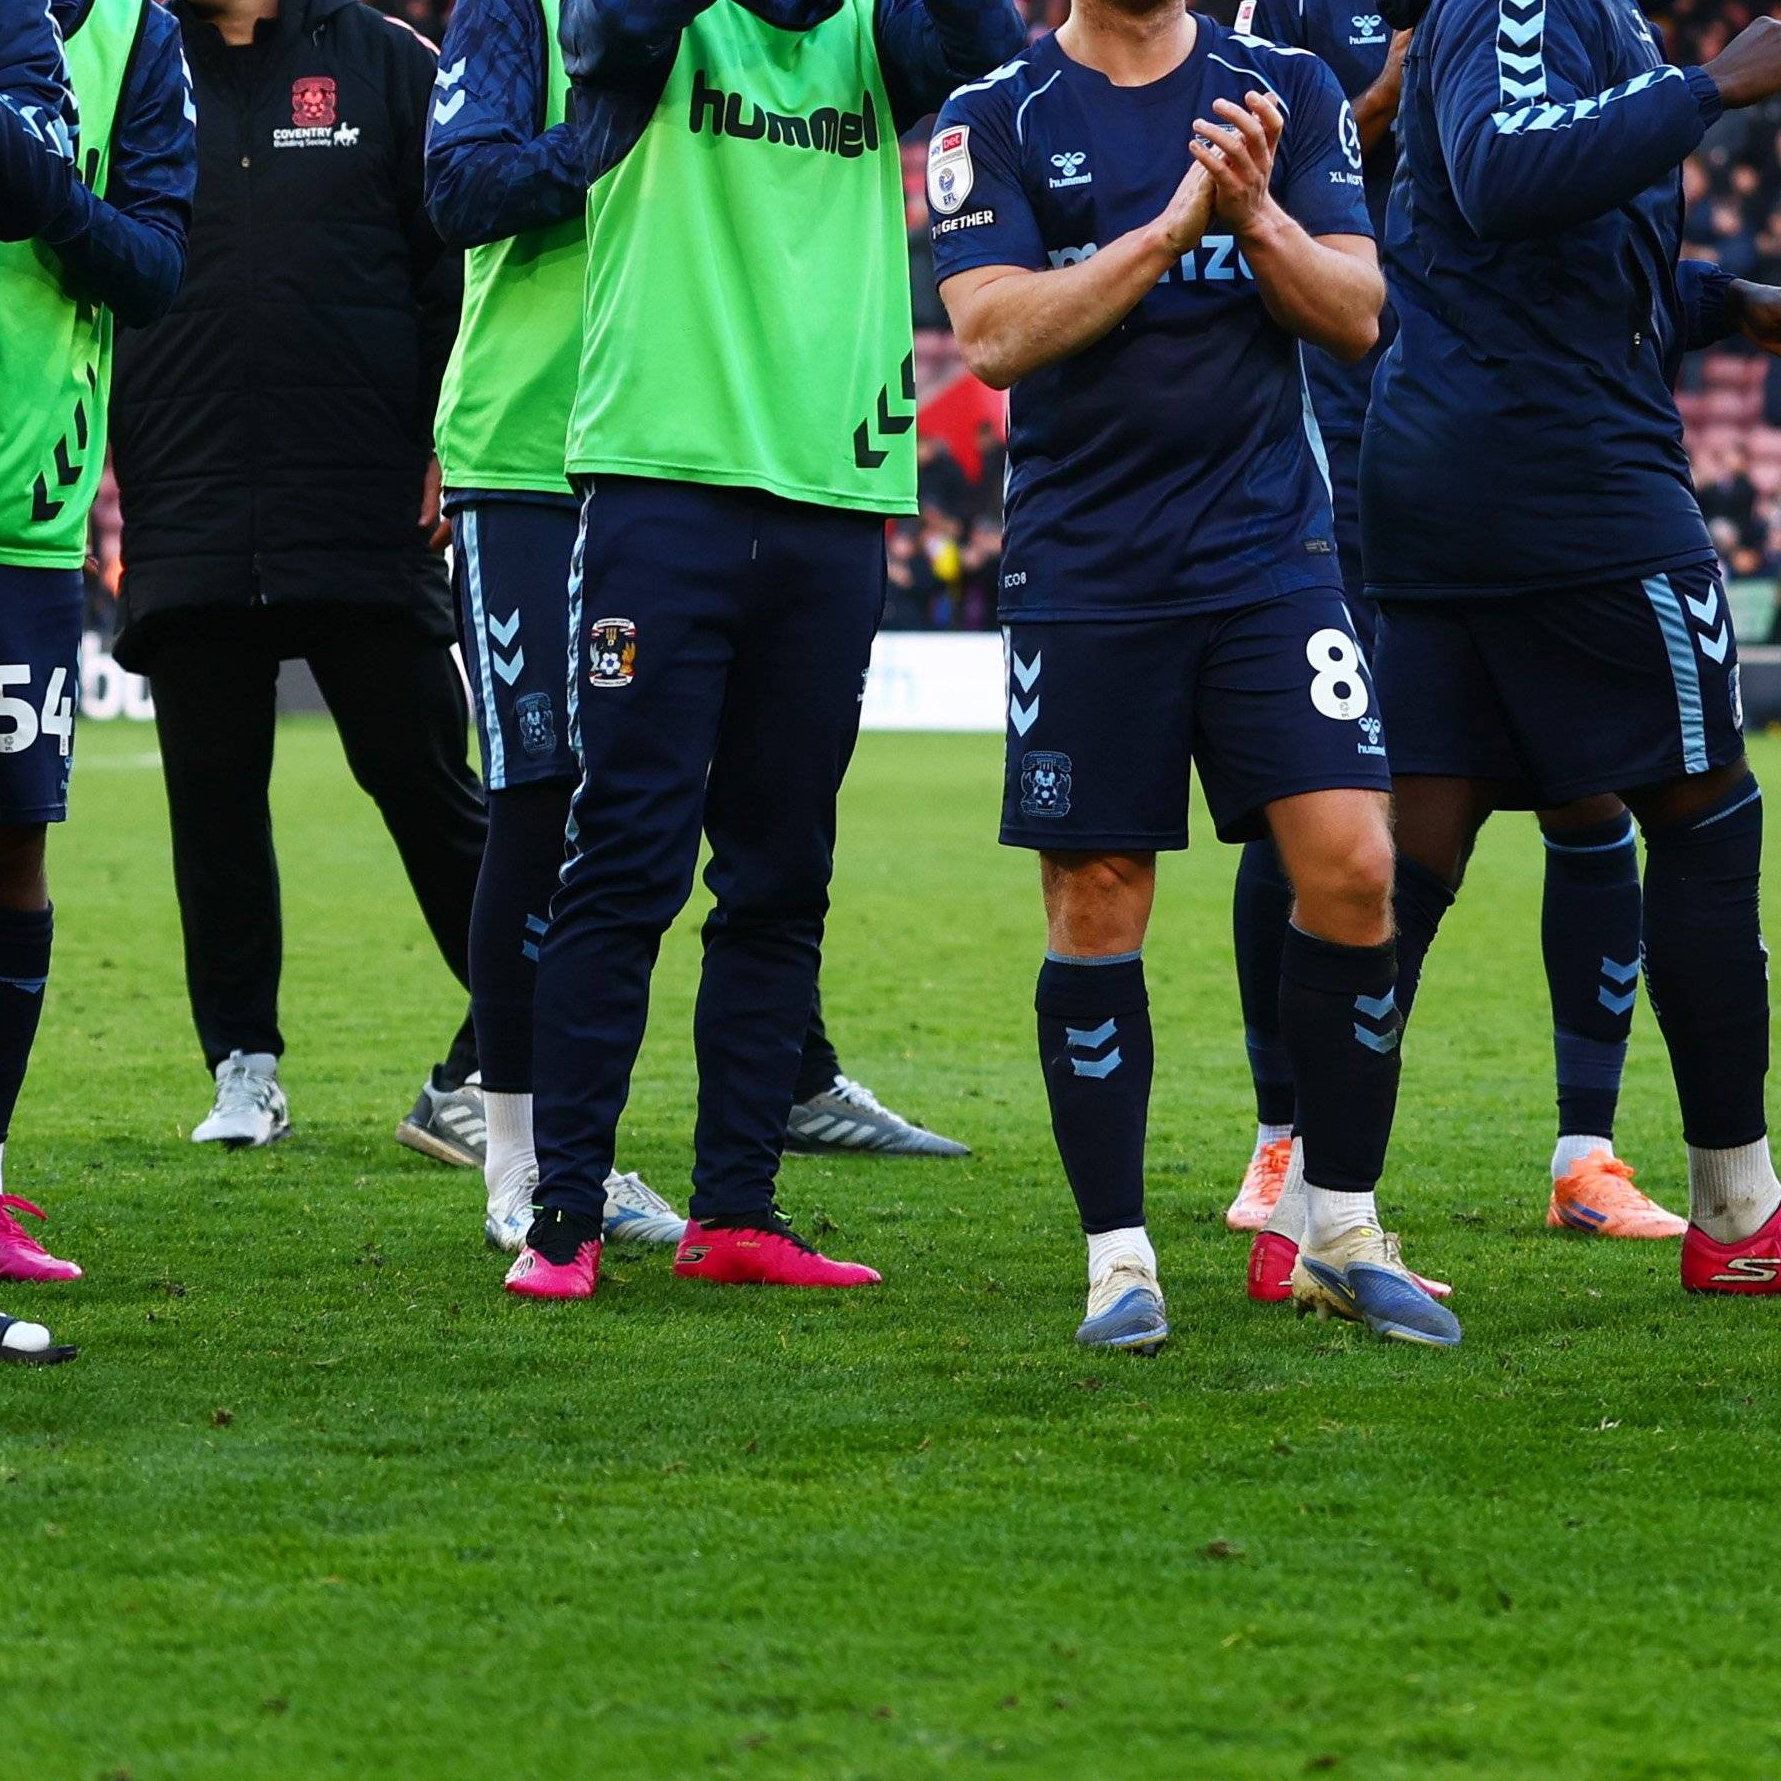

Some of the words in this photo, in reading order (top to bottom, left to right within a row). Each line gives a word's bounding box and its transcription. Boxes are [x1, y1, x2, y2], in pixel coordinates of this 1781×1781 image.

[689, 69, 879, 158] hummel
[273, 127, 332, 139] COVENTRY
[1049, 173, 1092, 189] hummel
[1329, 171, 1346, 183] XL
[943, 193, 957, 205] EFL
[1306, 628, 1369, 720] 8
